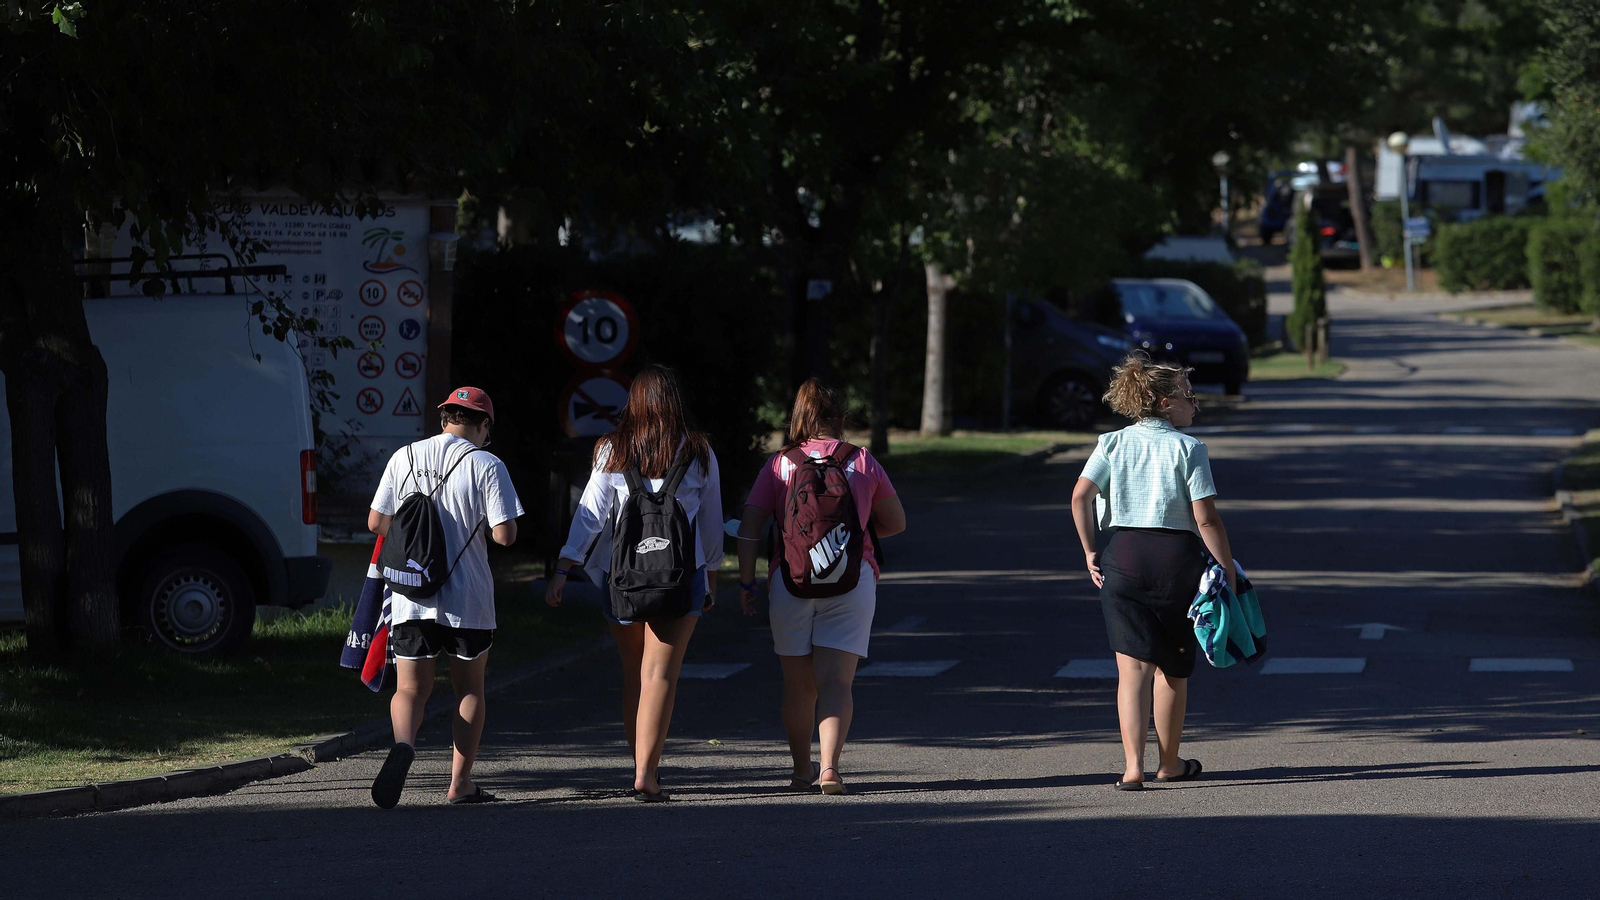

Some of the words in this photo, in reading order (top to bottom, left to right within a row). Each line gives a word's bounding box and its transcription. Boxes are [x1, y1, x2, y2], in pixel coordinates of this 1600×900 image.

[366, 287, 379, 299] 10
[577, 316, 618, 345] 10
[808, 522, 851, 576] NIKE
[383, 566, 422, 587] PUMA
